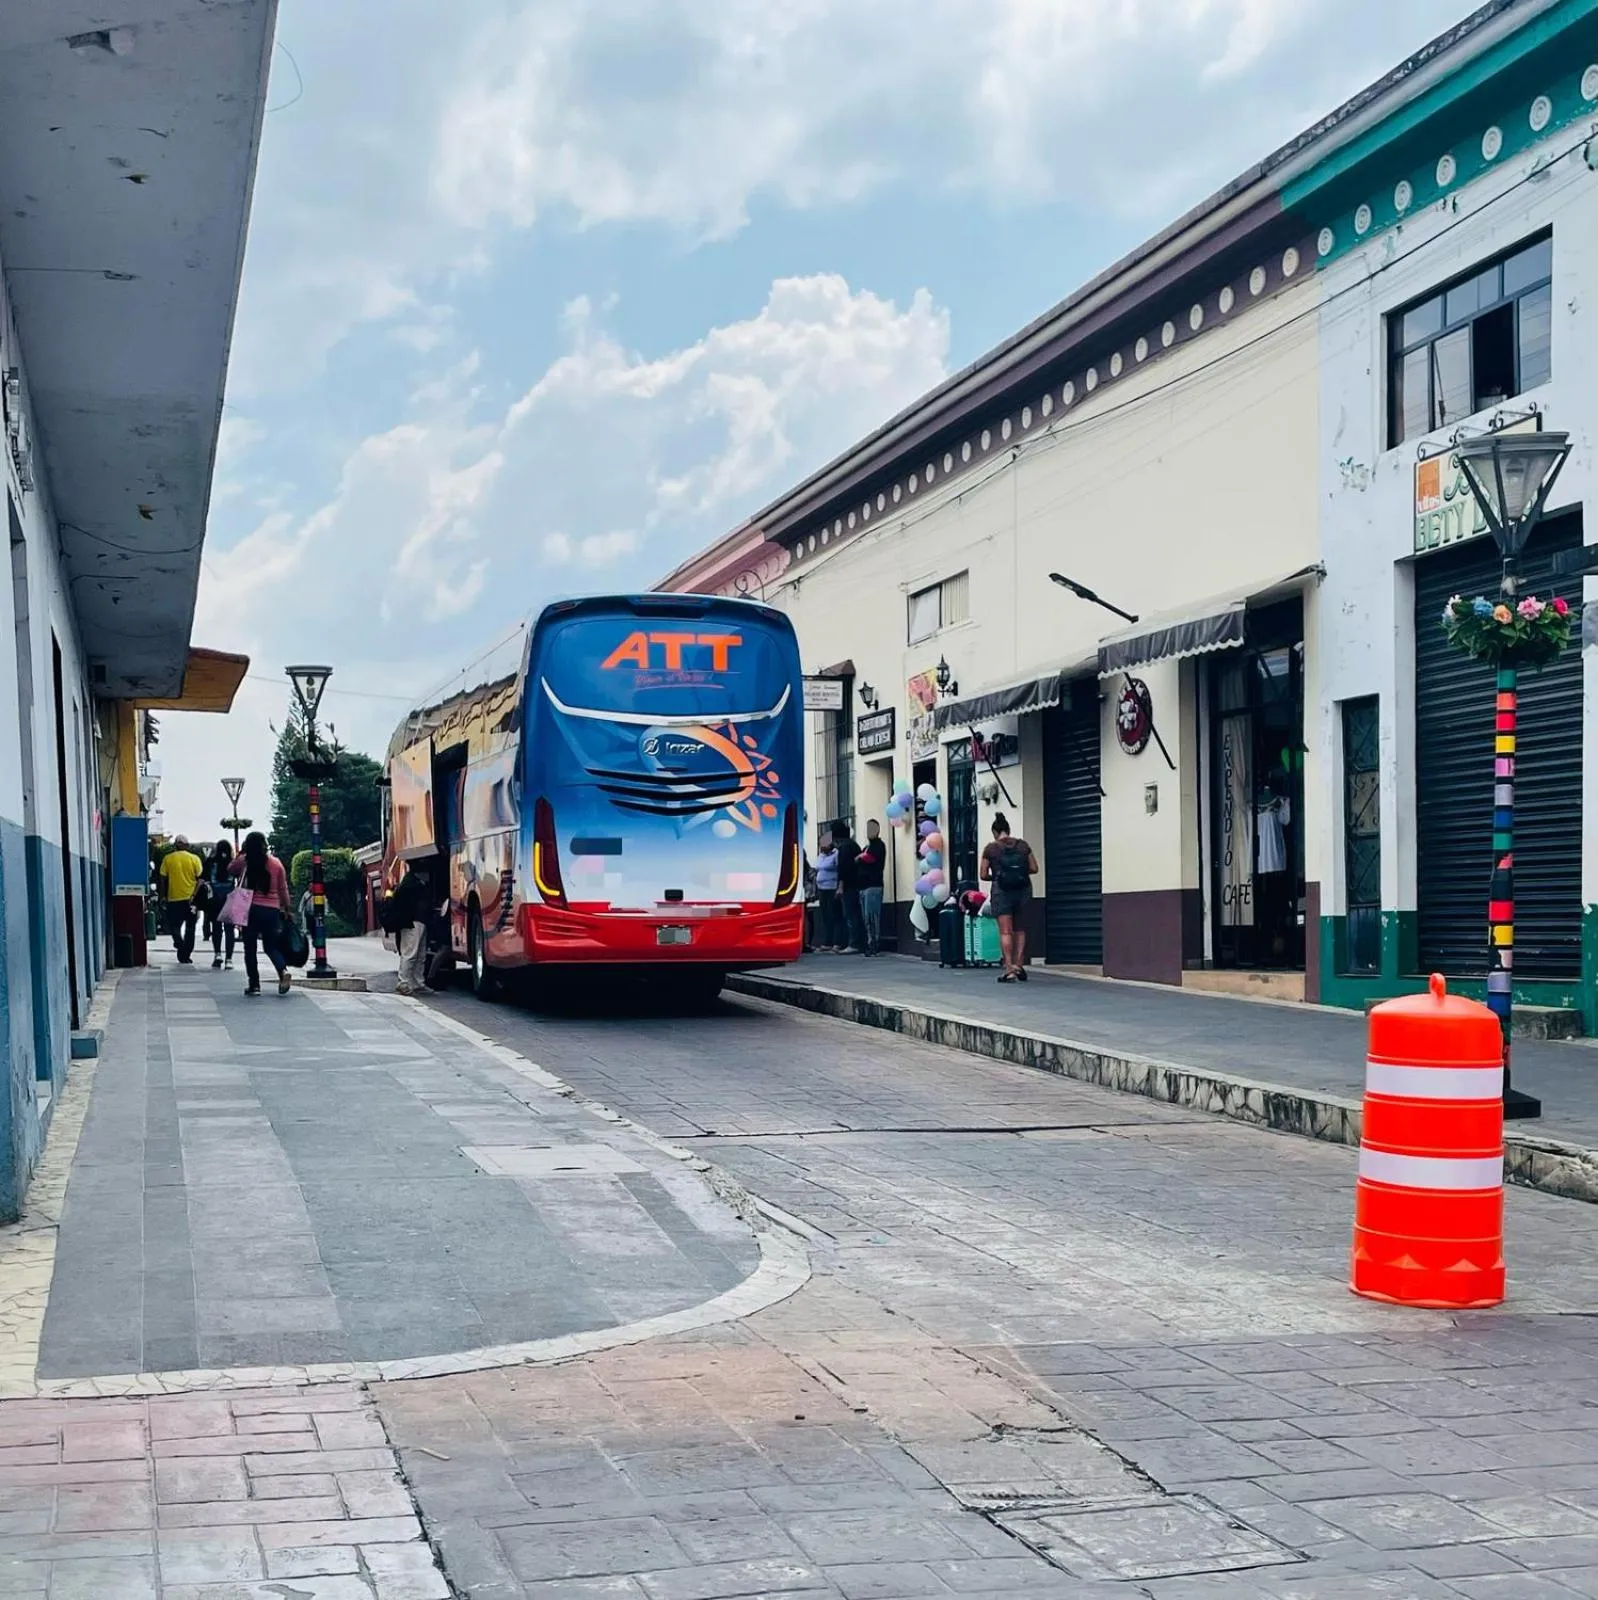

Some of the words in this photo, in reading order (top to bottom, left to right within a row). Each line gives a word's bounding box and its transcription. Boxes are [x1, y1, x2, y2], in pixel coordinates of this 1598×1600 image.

[600, 631, 743, 672] ATT
[1223, 734, 1233, 867] EXPENDIO
[1222, 878, 1252, 906] CAFÉ
